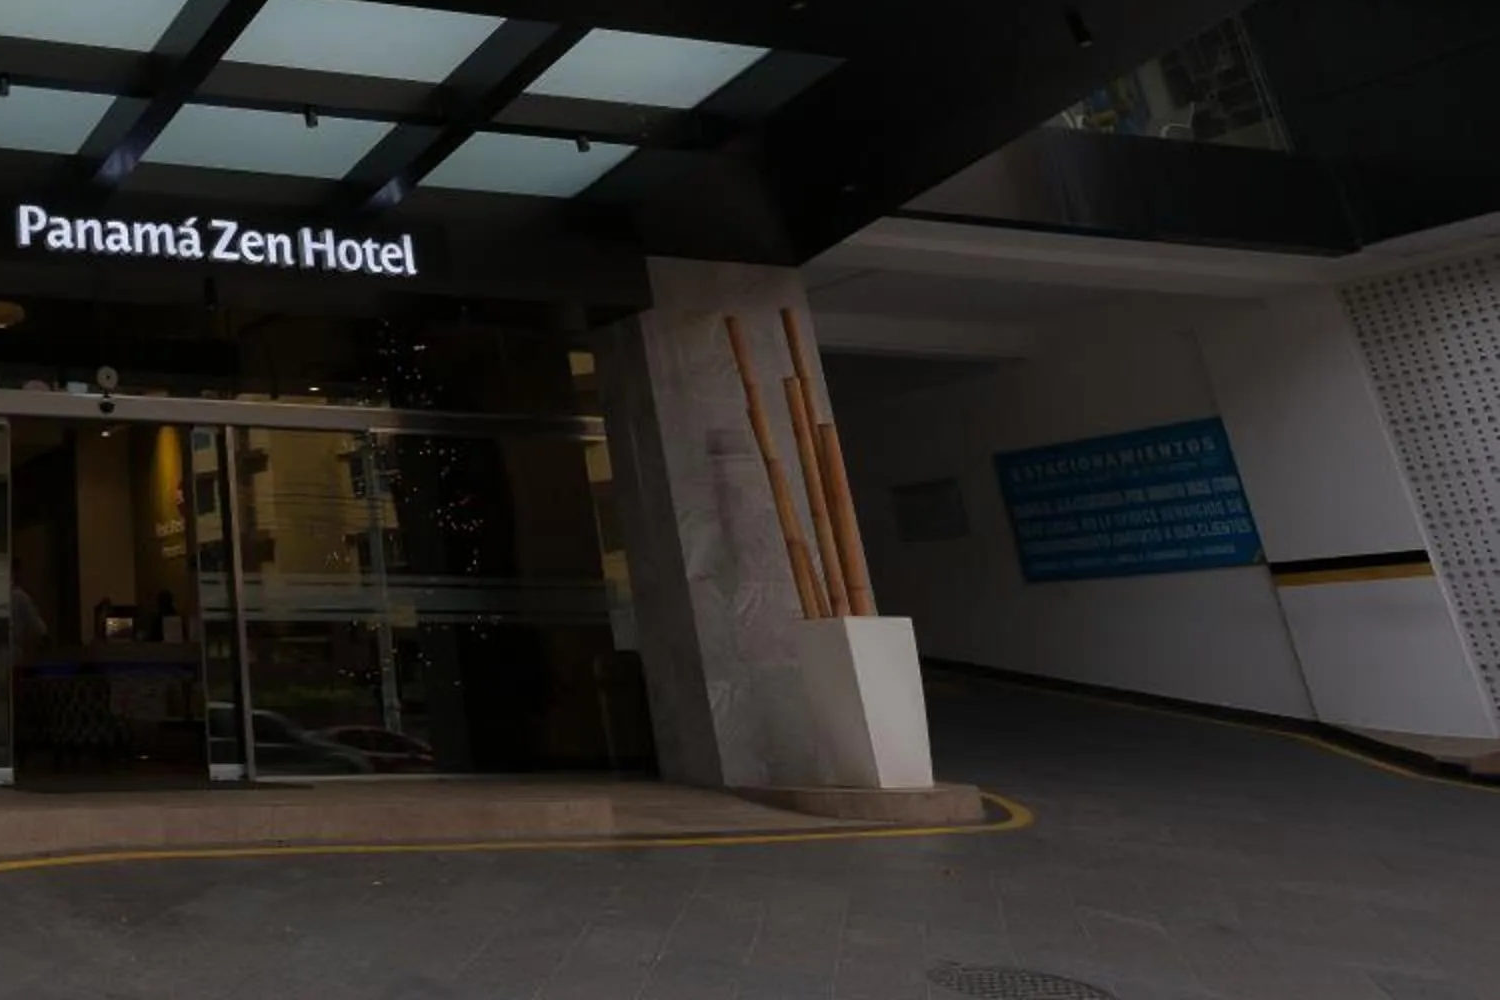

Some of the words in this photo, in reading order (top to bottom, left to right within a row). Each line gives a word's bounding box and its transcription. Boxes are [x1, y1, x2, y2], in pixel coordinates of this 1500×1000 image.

[17, 204, 203, 260] Panamá
[208, 218, 295, 265] Zen
[300, 226, 418, 275] Hotel
